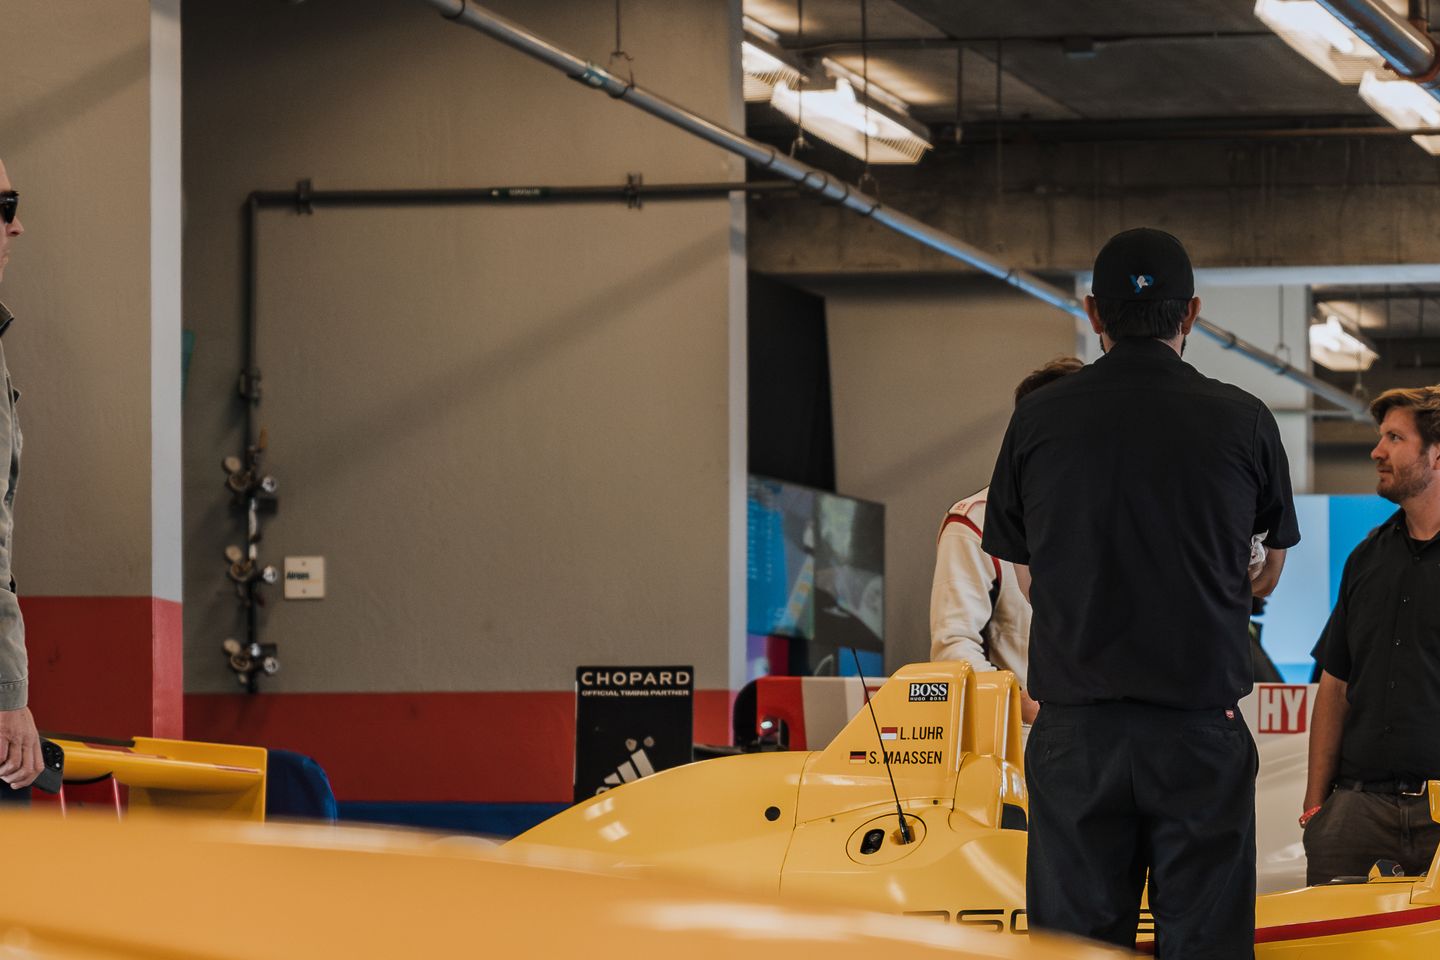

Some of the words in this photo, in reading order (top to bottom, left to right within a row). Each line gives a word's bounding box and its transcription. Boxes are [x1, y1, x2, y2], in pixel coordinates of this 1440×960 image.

[581, 671, 690, 686] CHOPARD
[582, 689, 618, 697] OFFICIAL
[910, 683, 947, 697] BOSS
[868, 750, 880, 764] S.
[883, 750, 942, 764] MAASSEN
